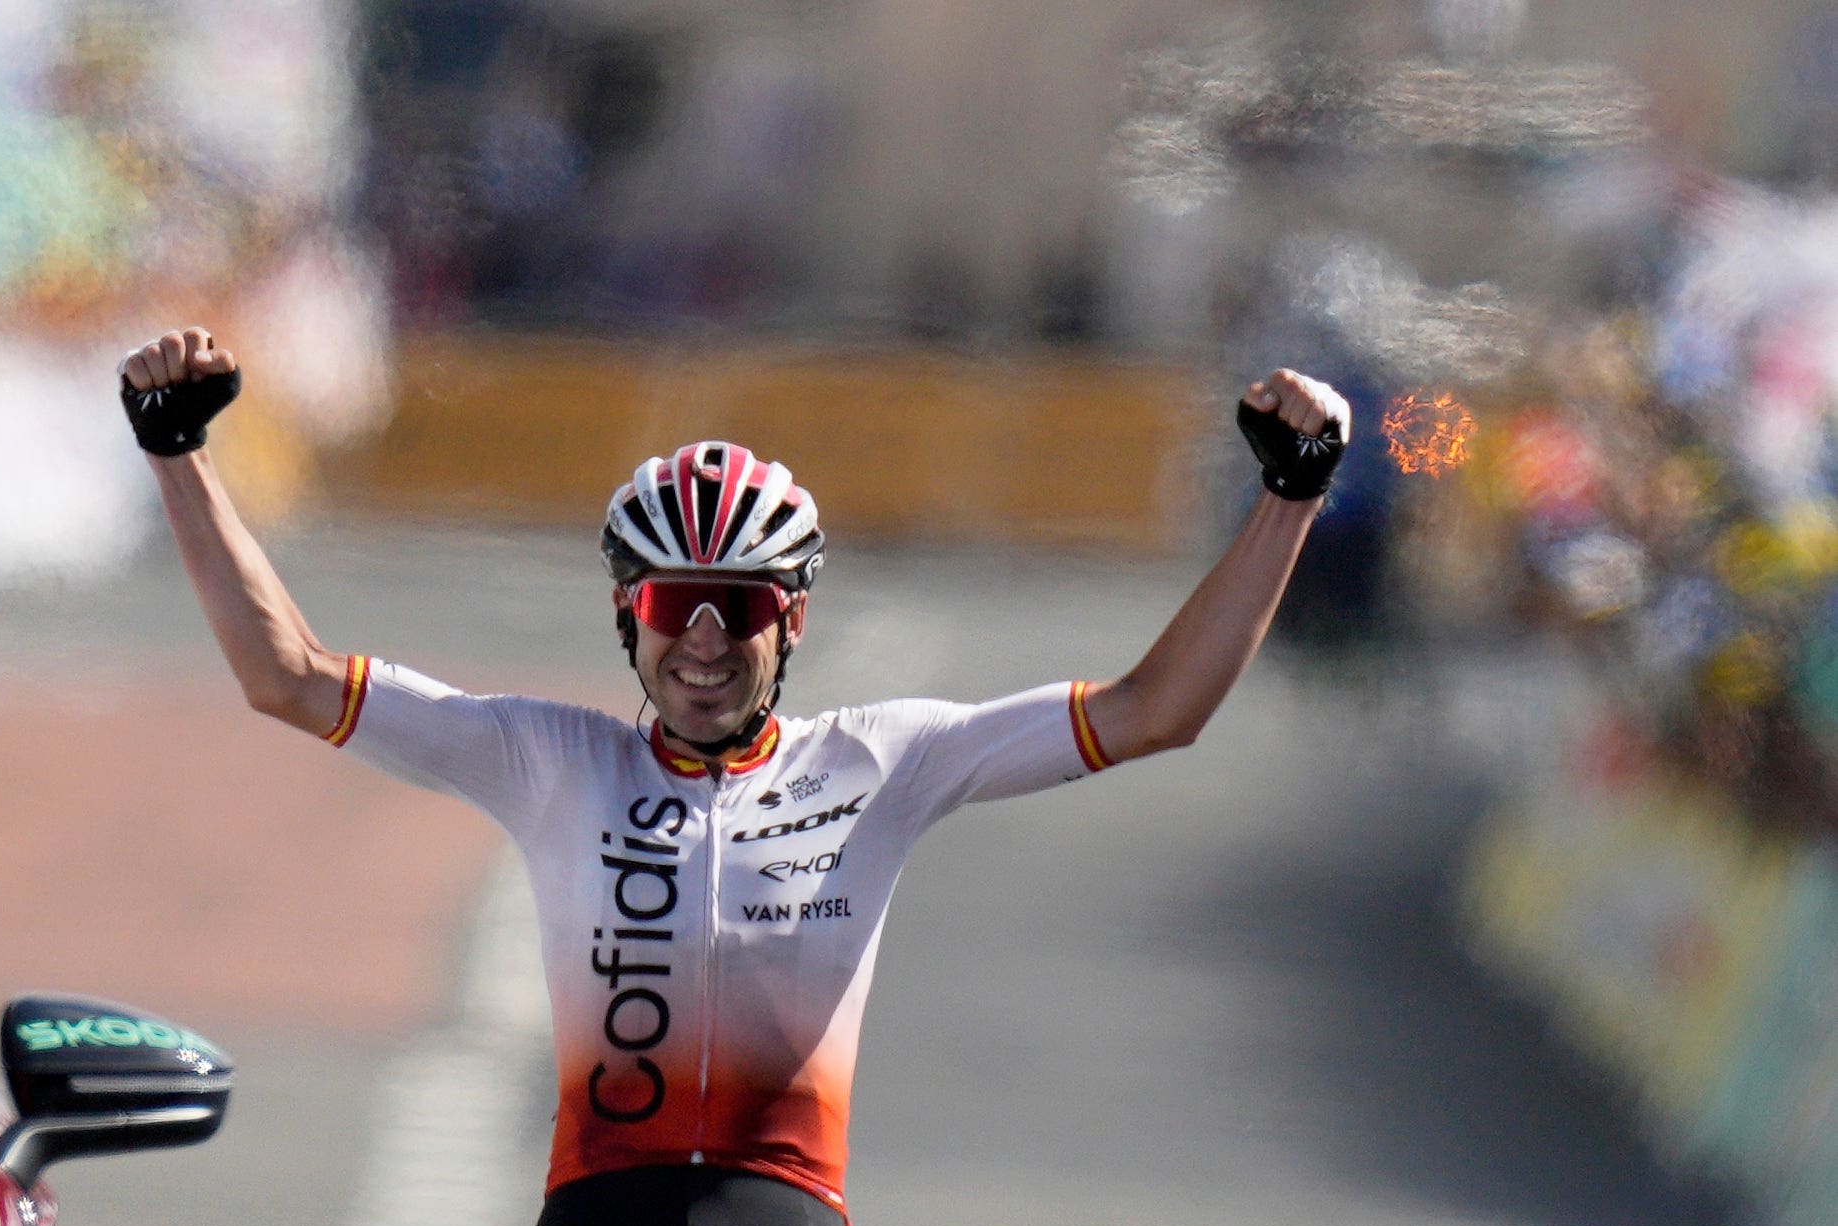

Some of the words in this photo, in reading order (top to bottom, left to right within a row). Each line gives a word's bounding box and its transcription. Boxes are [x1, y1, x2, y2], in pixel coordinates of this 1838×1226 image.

[731, 791, 869, 843] LOOK
[743, 904, 791, 923] VAN
[799, 896, 853, 921] RYSEL
